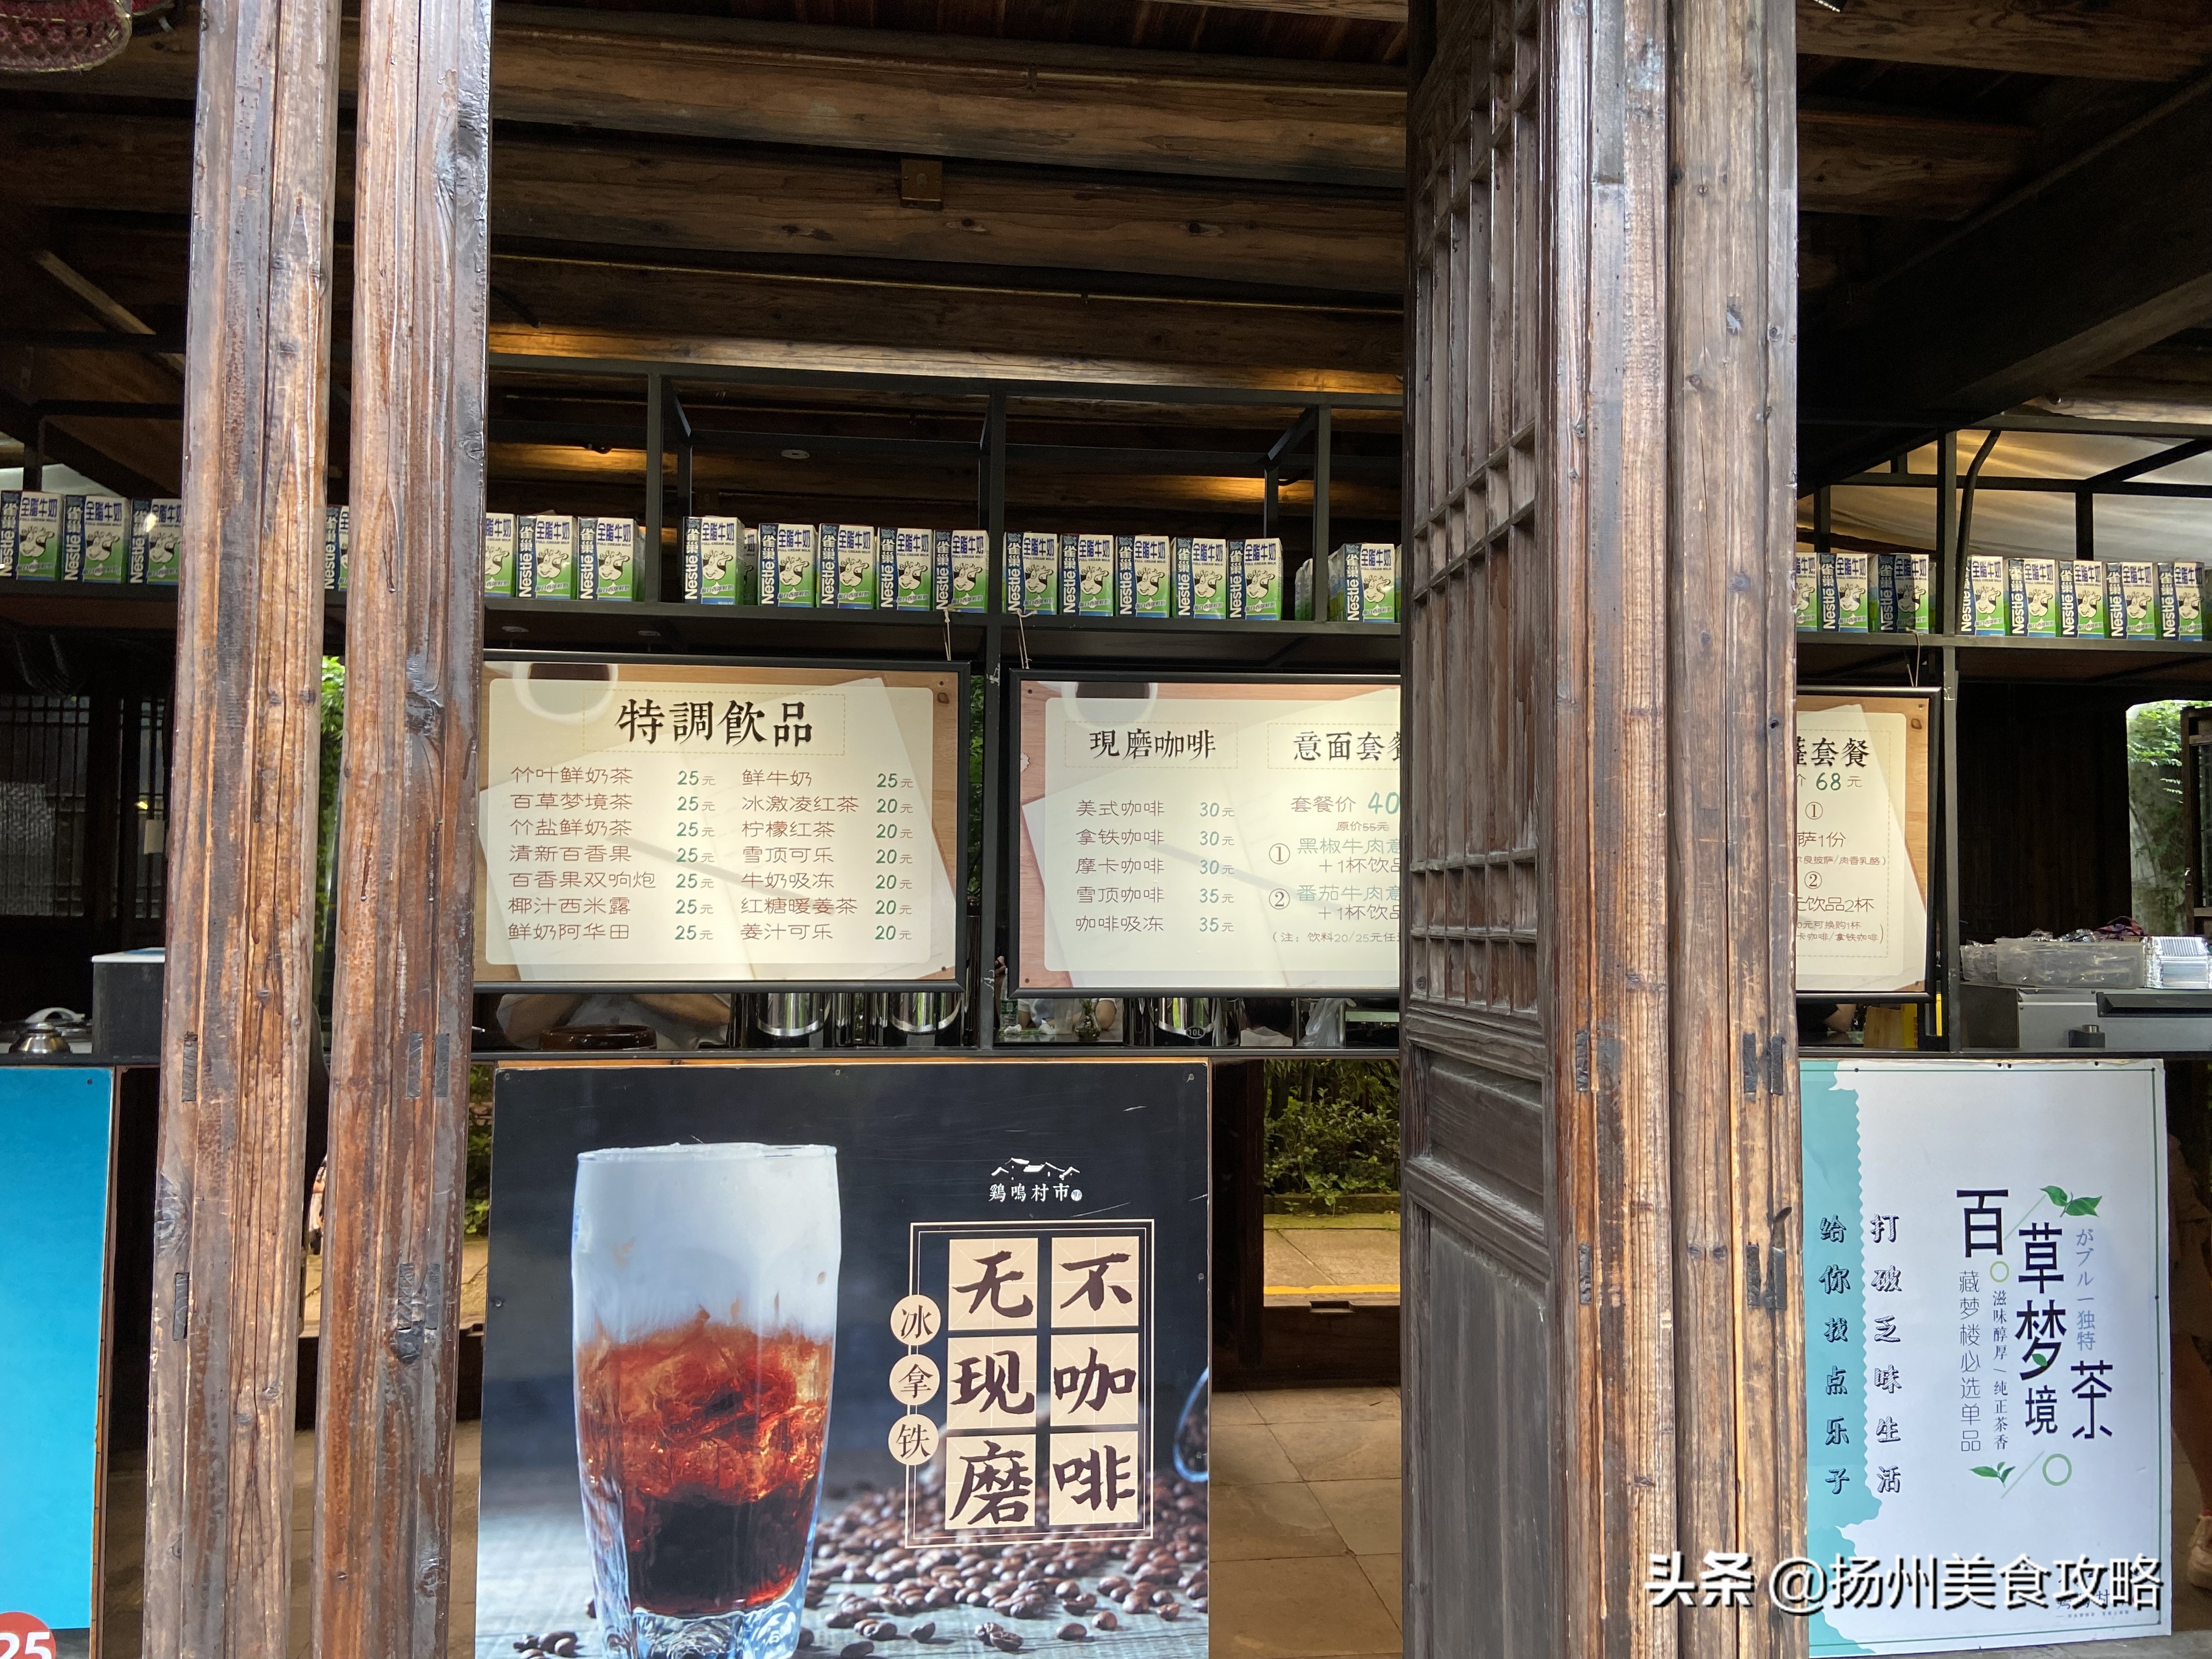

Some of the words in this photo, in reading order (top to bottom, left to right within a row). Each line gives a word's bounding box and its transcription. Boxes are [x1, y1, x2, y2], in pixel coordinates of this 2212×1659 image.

[521, 526, 534, 551] 雀巢
[537, 521, 569, 540] 全脂牛奶
[597, 523, 630, 542] 全脂牛奶
[702, 523, 734, 541] 全脂牛奶
[778, 529, 810, 548] 全脂牛奶
[839, 530, 870, 549] 全脂牛奶
[581, 528, 595, 553] 雀巢
[686, 529, 700, 553] 雀巢
[762, 535, 776, 560] 雀巢
[822, 535, 837, 560] 雀巢
[898, 533, 929, 552] 全脂牛奶
[952, 535, 984, 554] 全脂牛奶
[1024, 538, 1054, 556] 全脂牛奶
[1079, 539, 1110, 557] 全脂牛奶
[881, 539, 895, 563] 雀巢
[936, 541, 950, 566] 雀巢
[1008, 542, 1022, 566] 雀巢
[1063, 545, 1077, 569] 雀巢
[1119, 546, 1132, 571] 雀巢
[1135, 541, 1165, 559] 全脂牛奶
[1193, 543, 1223, 562] 全脂牛奶
[1245, 543, 1276, 561] 全脂牛奶
[1361, 549, 1391, 566] 全脂牛奶
[1178, 548, 1190, 573] 雀巢
[1230, 550, 1243, 574] 雀巢
[1346, 554, 1359, 578] 雀巢
[1837, 557, 1866, 575] 全脂牛奶
[1895, 558, 1926, 576] 全脂牛奶
[1972, 561, 2001, 578] 全脂牛奶
[1822, 563, 1835, 586] 雀巢
[2025, 564, 2053, 581] 全脂牛奶
[2075, 565, 2101, 583] 全脂牛奶
[511, 766, 633, 785] 竹叶鲜奶茶
[742, 769, 811, 787] 鲜牛奶
[510, 792, 633, 810] 百草梦境茶
[742, 795, 859, 812] 冰激凌红茶
[1076, 800, 1165, 817] 美式咖啡
[1291, 796, 1356, 812] 套餐价
[510, 819, 632, 836] 竹盐鲜奶茶
[742, 820, 835, 838] 柠檬红茶
[1076, 828, 1165, 845] 拿铁咖啡
[510, 845, 631, 862] 清新百香果
[743, 846, 834, 863] 雪顶可乐
[1075, 857, 1165, 874] 摩卡咖啡
[509, 871, 656, 888] 百香果双响炮
[741, 872, 834, 889] 牛奶吸冻
[1076, 887, 1165, 904] 雪顶咖啡
[508, 897, 631, 914] 椰汁西米露
[741, 897, 857, 915] 红糖暖姜茶
[508, 923, 629, 940] 鲜奶阿华田
[740, 923, 833, 940] 姜汁可乐
[1076, 916, 1164, 932] 咖啡吸冻
[1819, 1214, 1850, 1494] 给你找点乐子
[1870, 1214, 1902, 1493] 打破乏味生活
[1959, 1270, 1981, 1452] 藏梦楼必选单品
[895, 1305, 934, 1460] 冰拿铁
